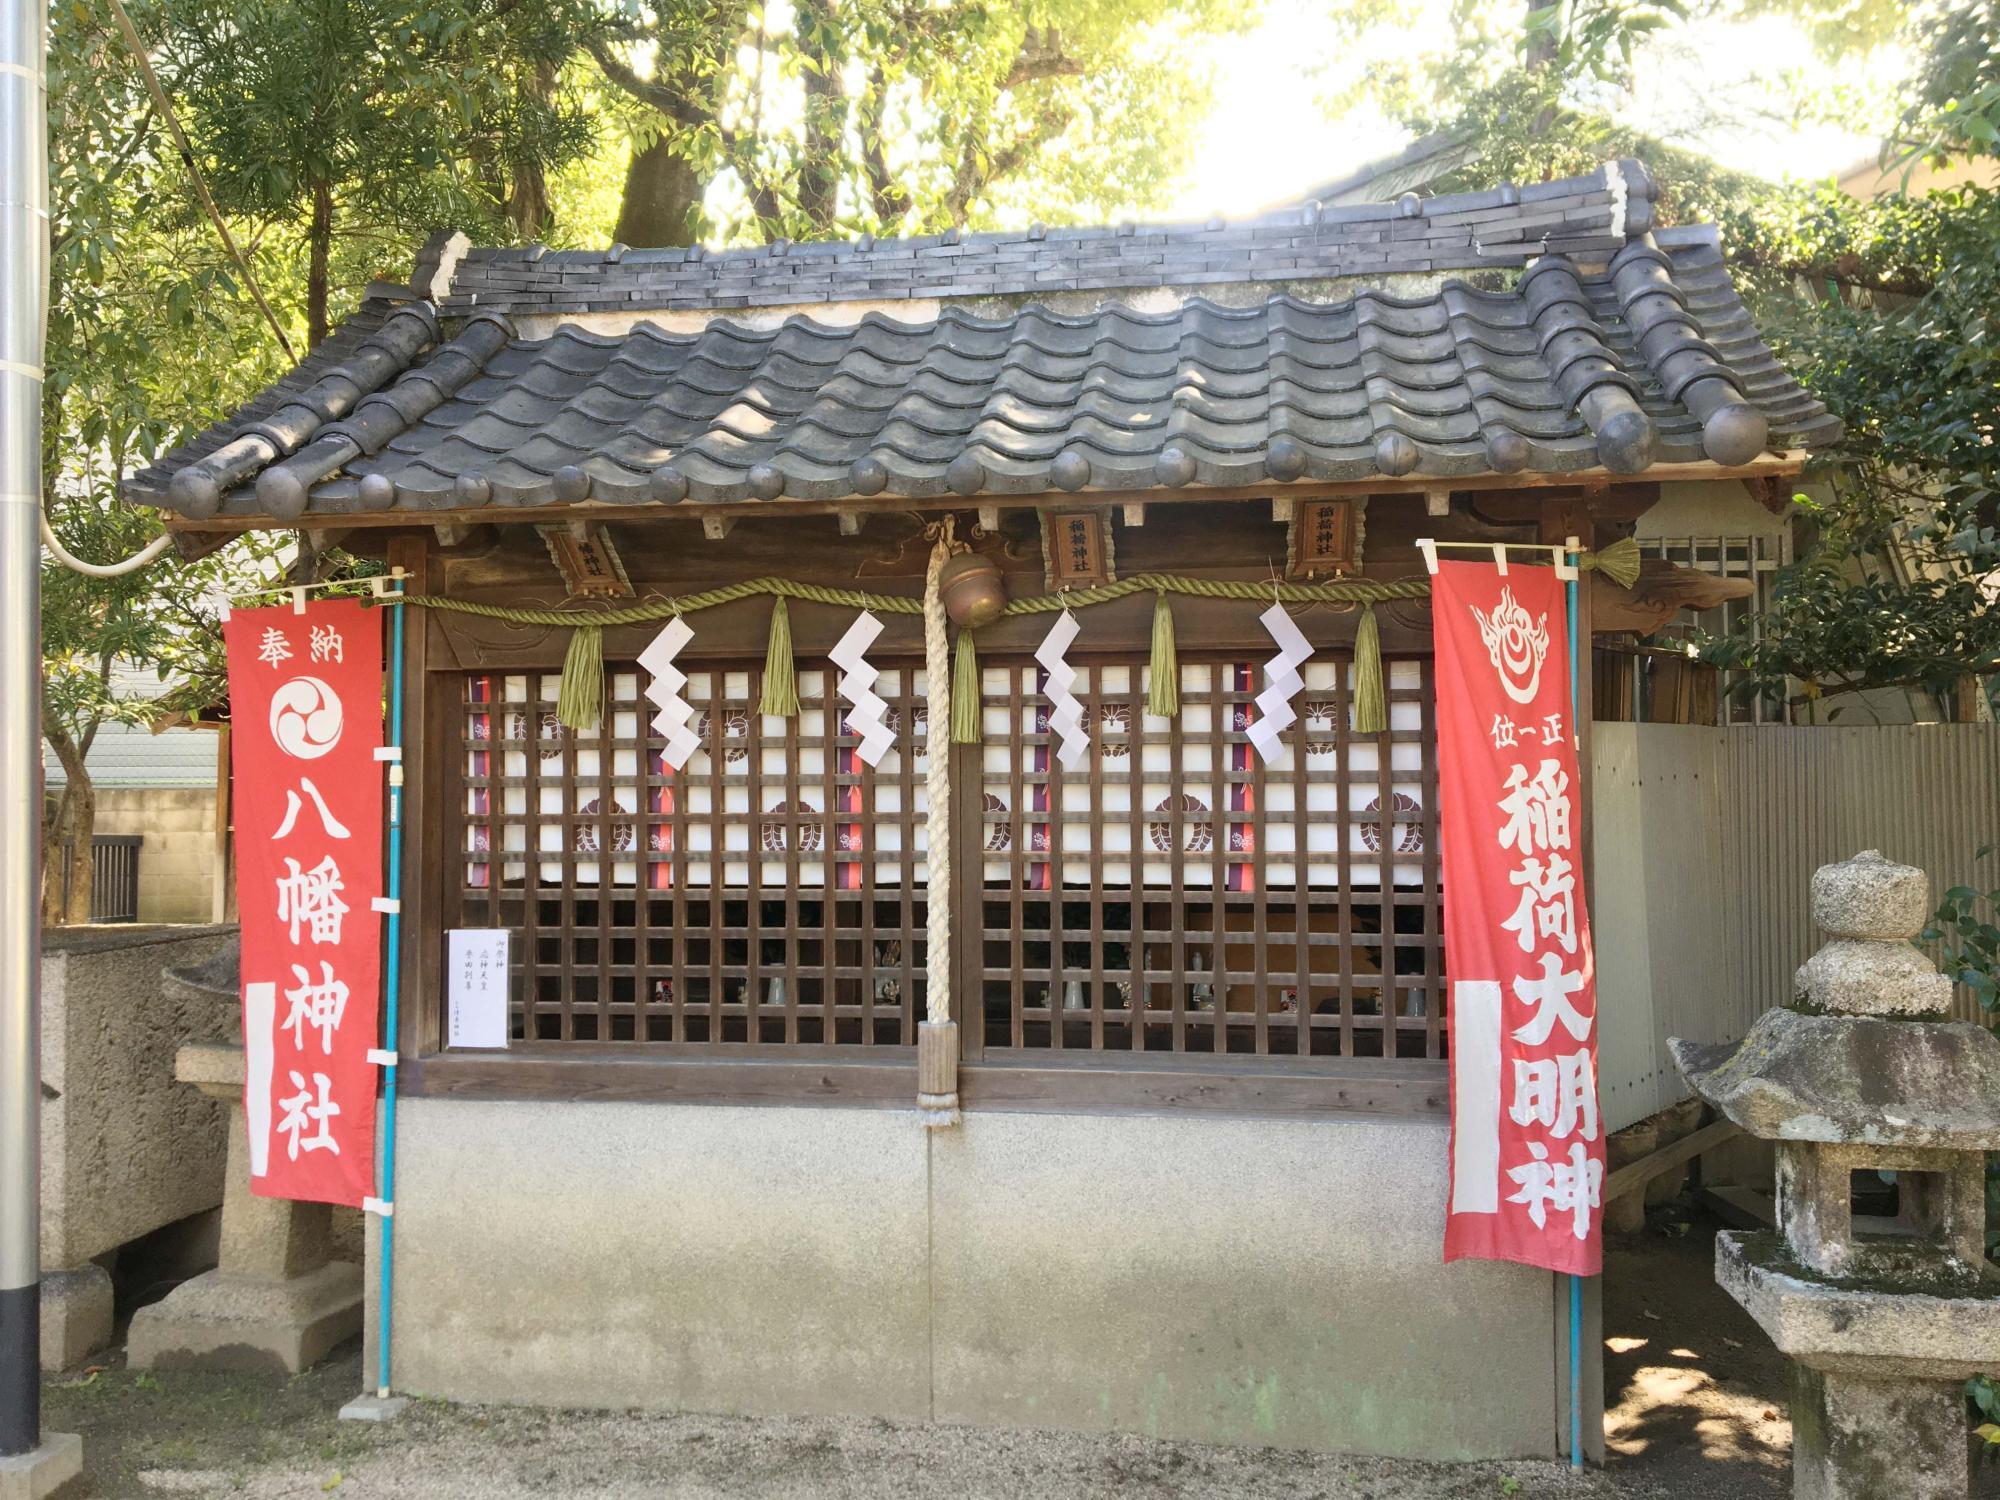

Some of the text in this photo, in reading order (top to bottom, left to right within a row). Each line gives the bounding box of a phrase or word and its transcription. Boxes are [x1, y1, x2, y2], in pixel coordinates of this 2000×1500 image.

[577, 543, 606, 576] 幡神社
[1068, 519, 1092, 572] 稲荷神社
[257, 624, 344, 670] 奉納
[271, 776, 352, 1161] 八幡神社
[1497, 758, 1603, 1240] 稲荷大明神
